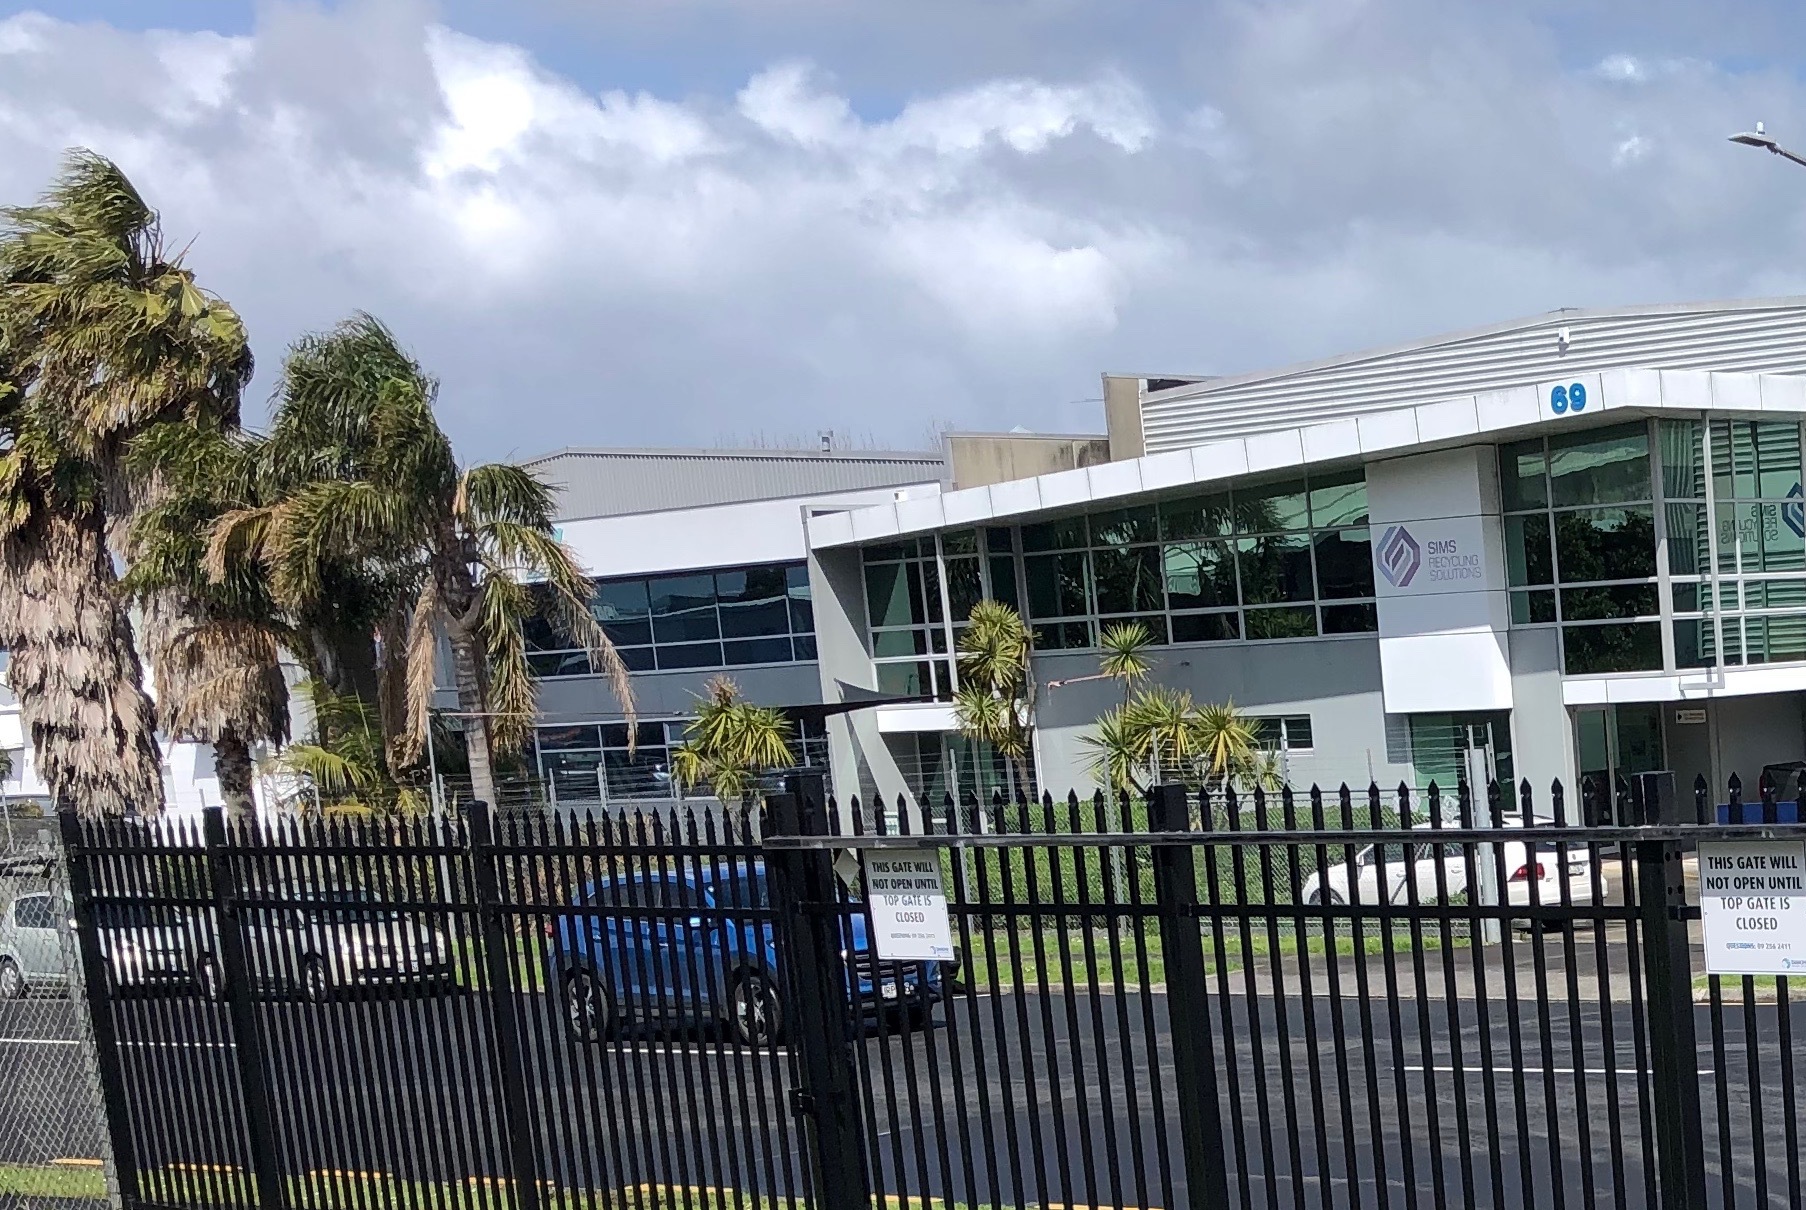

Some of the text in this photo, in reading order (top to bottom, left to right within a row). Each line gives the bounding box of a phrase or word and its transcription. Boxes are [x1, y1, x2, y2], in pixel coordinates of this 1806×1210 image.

[1551, 382, 1587, 415] 69
[1427, 539, 1457, 555] SIMS
[1428, 554, 1479, 569] RECYCLING
[1430, 566, 1482, 582] SOLUTIONS
[872, 861, 934, 873] THIS GATE WILL
[1707, 855, 1798, 870] THIS GATE WILL
[872, 878, 939, 890] NOT OPEN UNTIL
[1706, 876, 1803, 890] NOT OPEN UNTIL
[883, 894, 932, 907] TOP GATE IS
[1720, 896, 1790, 910] TOP GATE IS
[895, 911, 925, 923] CLOSED
[1736, 917, 1778, 930] CLOSED
